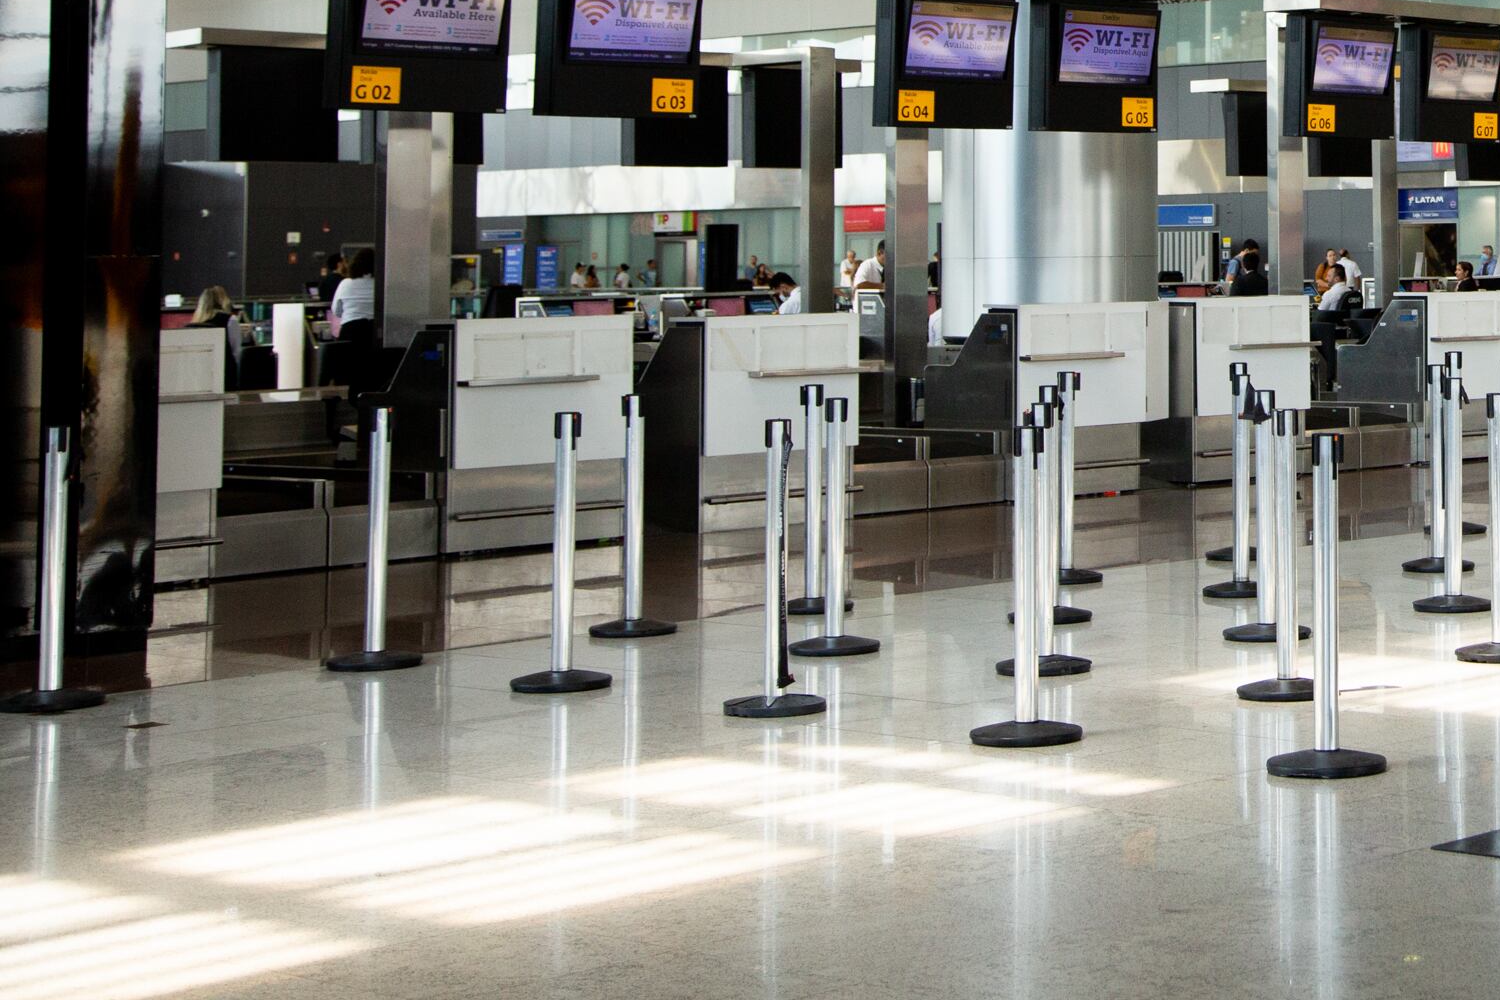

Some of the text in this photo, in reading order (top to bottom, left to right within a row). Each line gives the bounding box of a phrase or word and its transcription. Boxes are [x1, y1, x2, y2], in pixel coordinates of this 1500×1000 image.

[413, 8, 496, 22] Available Here
[667, 22, 688, 31] Aqui
[946, 22, 1006, 42] WI-FI
[944, 40, 982, 50] Available
[1096, 30, 1151, 48] WI-FI
[1344, 44, 1389, 62] WI-FI
[1456, 52, 1498, 68] WI-FI
[356, 84, 392, 100] G 02
[656, 96, 686, 110] G 03
[902, 106, 928, 118] G 04
[1126, 112, 1148, 124] G 05
[1310, 118, 1330, 130] G 06
[1476, 126, 1494, 136] G 07
